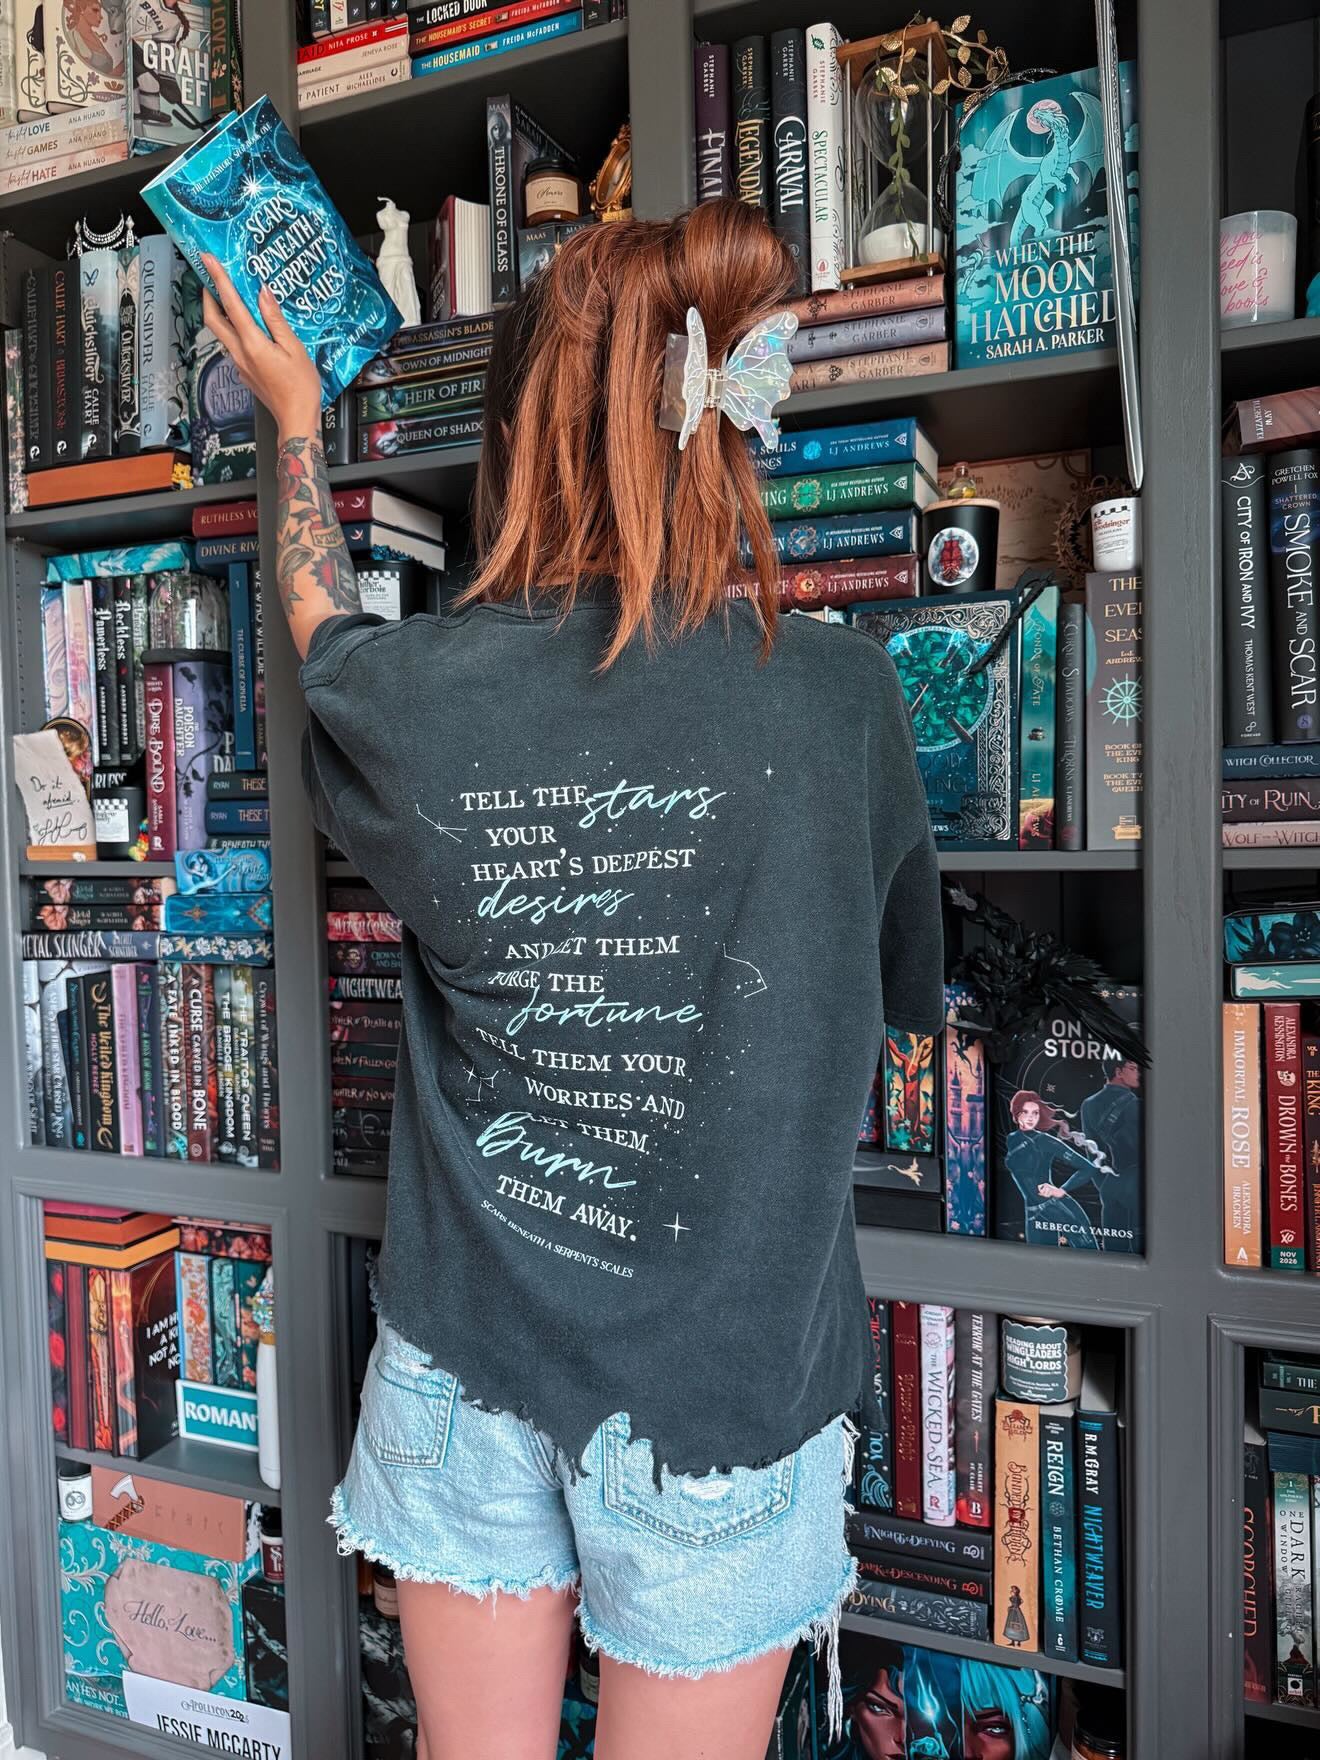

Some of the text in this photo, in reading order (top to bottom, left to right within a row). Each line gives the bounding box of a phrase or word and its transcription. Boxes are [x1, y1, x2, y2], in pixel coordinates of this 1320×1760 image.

[426, 1, 461, 24] LOCKED
[346, 33, 369, 44] PROSE
[428, 16, 491, 42] HOUSEMAID'S SECRET
[143, 39, 210, 73] GRAH
[432, 22, 560, 68] HOUSEMAID FREIDA McFADDEN
[306, 76, 386, 99] PATIENT MICHAELIDES
[28, 109, 106, 136] LOVE HUANG
[27, 140, 58, 155] GAMES
[32, 157, 106, 181] HATE HUANG
[774, 115, 807, 214] CARAVAL
[811, 130, 829, 223] SPECTACULAR
[246, 190, 297, 244] SCARS
[495, 146, 509, 273] THRONE OF GLASS
[247, 217, 315, 282] BENEATH
[526, 232, 546, 242] MAAS
[995, 231, 1096, 268] WHEN THE
[270, 230, 337, 304] SERPENT'S
[994, 254, 1096, 305] MOON
[296, 264, 344, 323] SCALES
[843, 281, 905, 299] STEPHANIE
[851, 296, 896, 310] GARBER
[1224, 295, 1270, 315] books
[141, 259, 154, 363] QUICKSILVER
[844, 316, 906, 332] STEPHANIE
[413, 321, 494, 343] ASSASSIN'S BLADE
[852, 330, 897, 344] GARBER
[985, 329, 1105, 359] SARAH PARKER
[121, 330, 135, 404] QUICKSILVER
[444, 346, 493, 364] MIDNIGHT
[850, 352, 912, 368] STEPHANIE
[858, 366, 904, 380] GARBER
[84, 389, 93, 424] HART
[404, 385, 458, 405] HEIR OF
[397, 427, 449, 443] QUEEN OF
[842, 440, 890, 454] ANDREWS
[1275, 465, 1315, 476] GRETCHEN
[839, 484, 889, 500] ANDREWS
[1275, 494, 1317, 504] SHATTERED
[1282, 502, 1311, 510] CROWN
[201, 512, 244, 525] RUTHLESS
[201, 543, 237, 558] DIVINE
[836, 533, 885, 547] ANDREWS
[840, 577, 889, 591] ANDREWS
[1109, 578, 1143, 591] THE
[1237, 496, 1255, 715] CITY OF IRON AND IVY THOMAS KENT WEST
[1284, 513, 1317, 709] SMOKE AND SCAR
[115, 600, 131, 660] Reckless
[175, 698, 185, 757] DAUGHTER
[184, 705, 194, 748] POISON
[1226, 755, 1319, 767] WITCH COLLECTOR
[460, 779, 727, 829] TELL THE stars
[1264, 789, 1320, 811] RUIN
[238, 809, 263, 822] THESE
[486, 826, 557, 847] YOUR
[471, 848, 696, 881] HEART'S DEEPEST
[477, 874, 635, 924] desires
[54, 931, 102, 957] SLINGER
[505, 936, 680, 960] AND LET THEM
[489, 971, 605, 993] PURGE THE
[506, 986, 704, 1037] fortune,
[476, 1027, 687, 1077] TELL THEM YOUR
[1044, 1039, 1123, 1061] STORM
[1275, 1016, 1285, 1062] KENNINGTON
[1286, 1017, 1296, 1060] ALEXANDRA
[167, 990, 182, 1130] FATE INKED BLOOD
[190, 989, 207, 1130] CURSE CARVED BONE
[221, 992, 235, 1139] THE BRIDGE KINGDOM
[1234, 1031, 1246, 1103] IMMORTAL
[99, 1031, 114, 1125] Veiled Kingdom
[240, 1029, 251, 1141] TRAITOR QUEEN
[525, 1077, 685, 1120] WORRIES AND
[1232, 1107, 1251, 1168] ROSE
[1278, 1096, 1297, 1211] DROWN BONES
[496, 1175, 637, 1242] THEM AWAY.
[1233, 1186, 1241, 1229] BRACKEN
[1242, 1181, 1252, 1235] ALEXANDRA
[481, 1200, 508, 1222] SCARS
[508, 1220, 545, 1247] BENEATH
[600, 1260, 634, 1278] SCALES
[1035, 1220, 1134, 1239] REBECCA YARROS
[152, 1317, 169, 1335] AM
[149, 1351, 167, 1367] NOT
[1007, 1342, 1062, 1358] WINGLEADERS
[971, 1313, 984, 1422] TERROR THE GATES
[1030, 1361, 1062, 1370] LORDS
[185, 1401, 258, 1432] ROMAN
[925, 1370, 944, 1488] WICKED SEA
[1047, 1440, 1064, 1574] REIGN BETHAN
[910, 1535, 956, 1553] DEFYING
[1083, 1504, 1105, 1609] NIGHTWEAVER
[1281, 1524, 1289, 1574] WINDOW
[1289, 1519, 1306, 1582] DARK
[891, 1568, 957, 1590] DESCENDING
[124, 1600, 169, 1630] Hello,
[849, 1591, 896, 1613] DYING
[207, 1728, 281, 1760] MCCARTY
